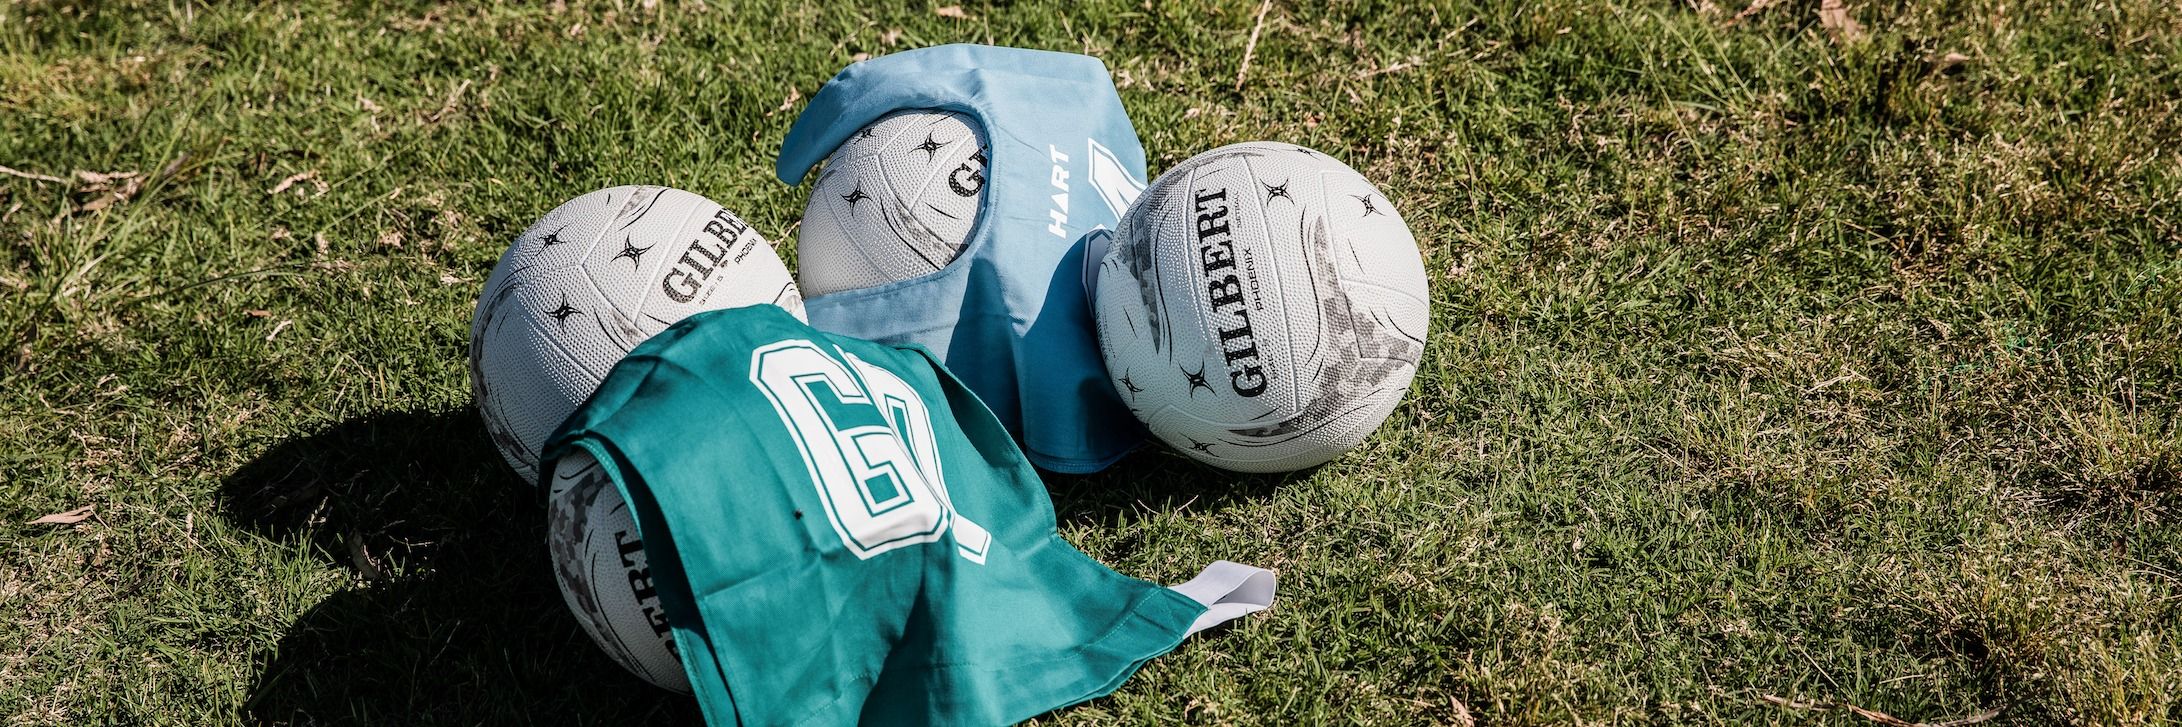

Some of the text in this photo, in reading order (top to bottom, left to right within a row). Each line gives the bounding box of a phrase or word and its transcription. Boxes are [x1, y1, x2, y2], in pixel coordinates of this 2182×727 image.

[948, 143, 989, 197] GI
[1048, 143, 1070, 239] HART
[662, 207, 749, 304] GILBE
[1195, 187, 1268, 398] GILBERT
[1243, 246, 1264, 311] PHOENIX
[615, 529, 683, 665] ERT
